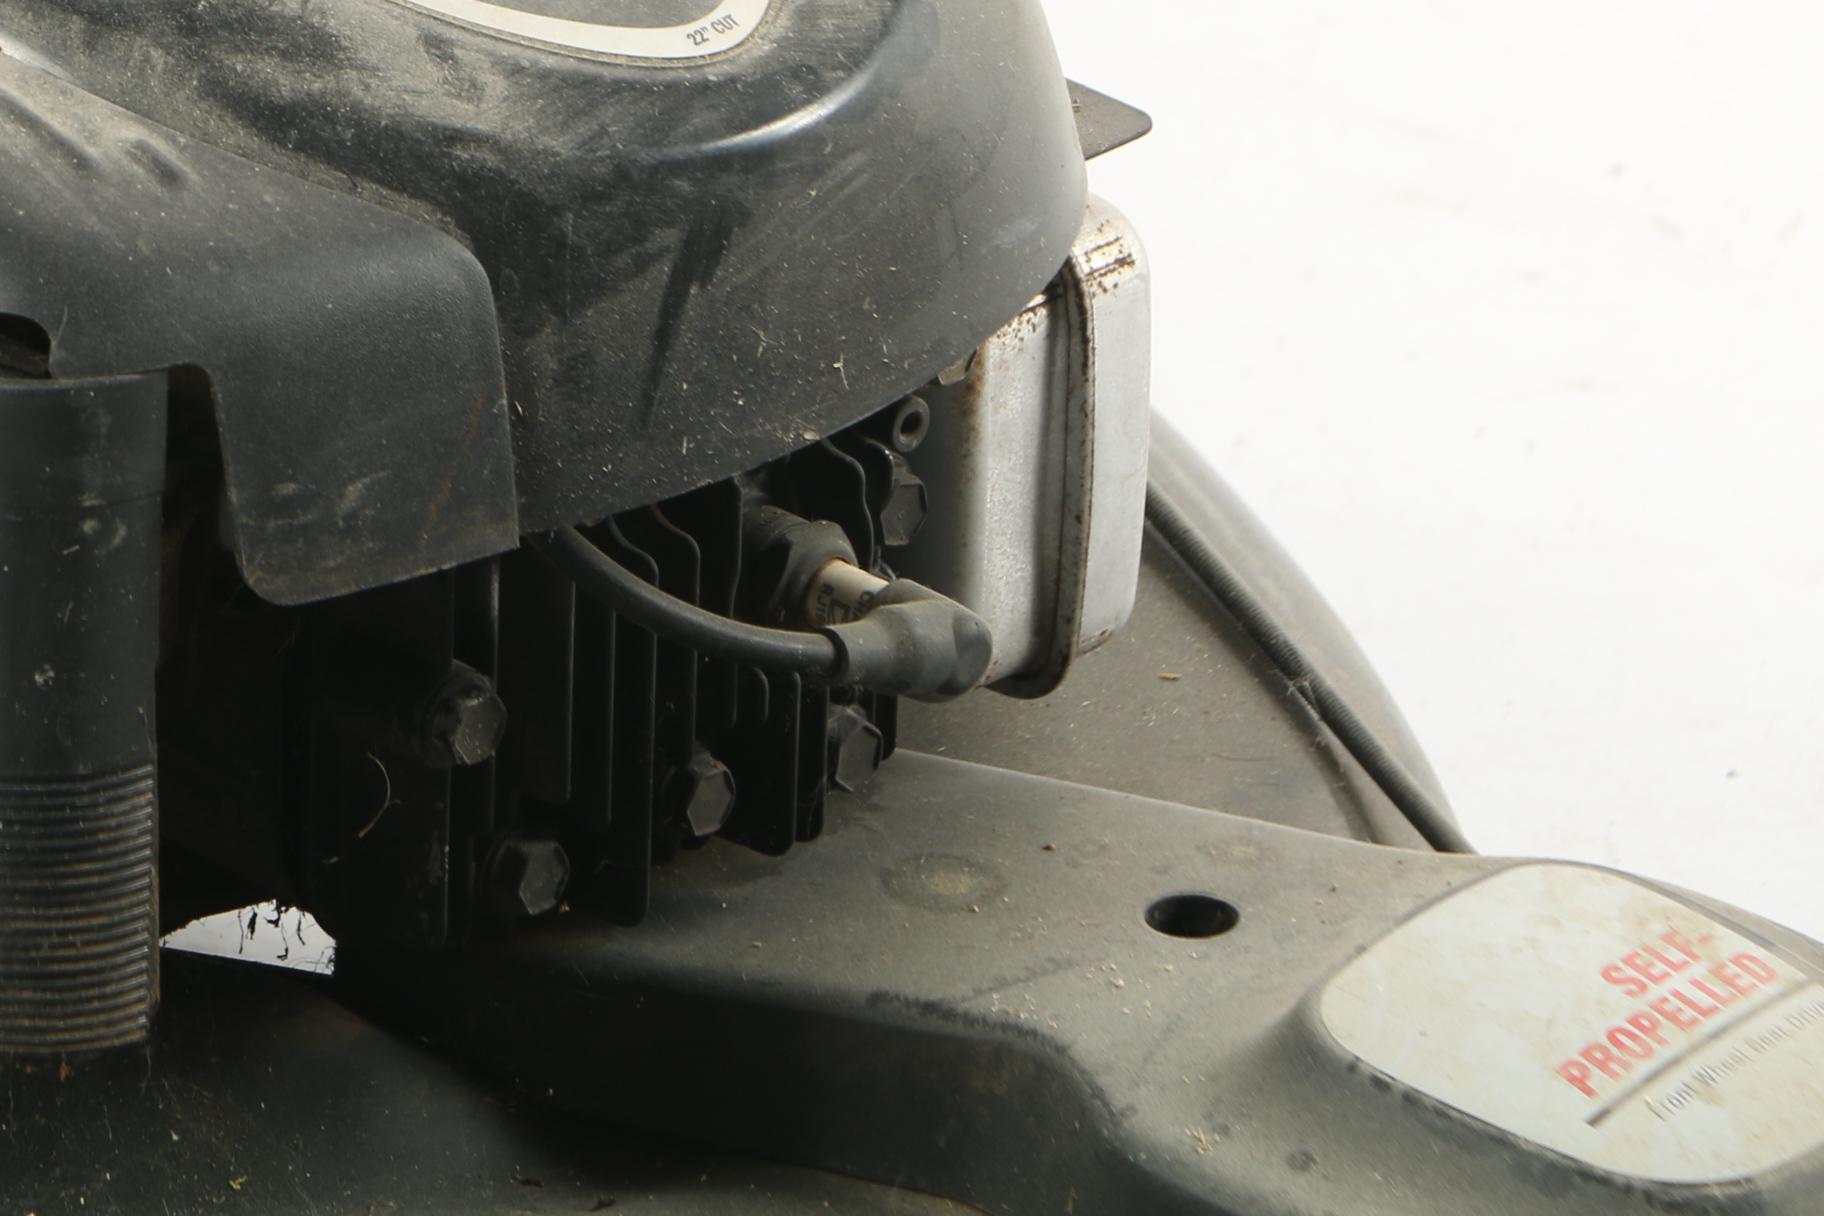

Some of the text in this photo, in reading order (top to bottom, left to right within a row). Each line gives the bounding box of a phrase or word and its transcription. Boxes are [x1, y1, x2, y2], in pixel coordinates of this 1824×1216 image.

[709, 13, 741, 37] CUT
[1599, 930, 1716, 1000] SELF-
[1555, 951, 1778, 1101] PROPELLED
